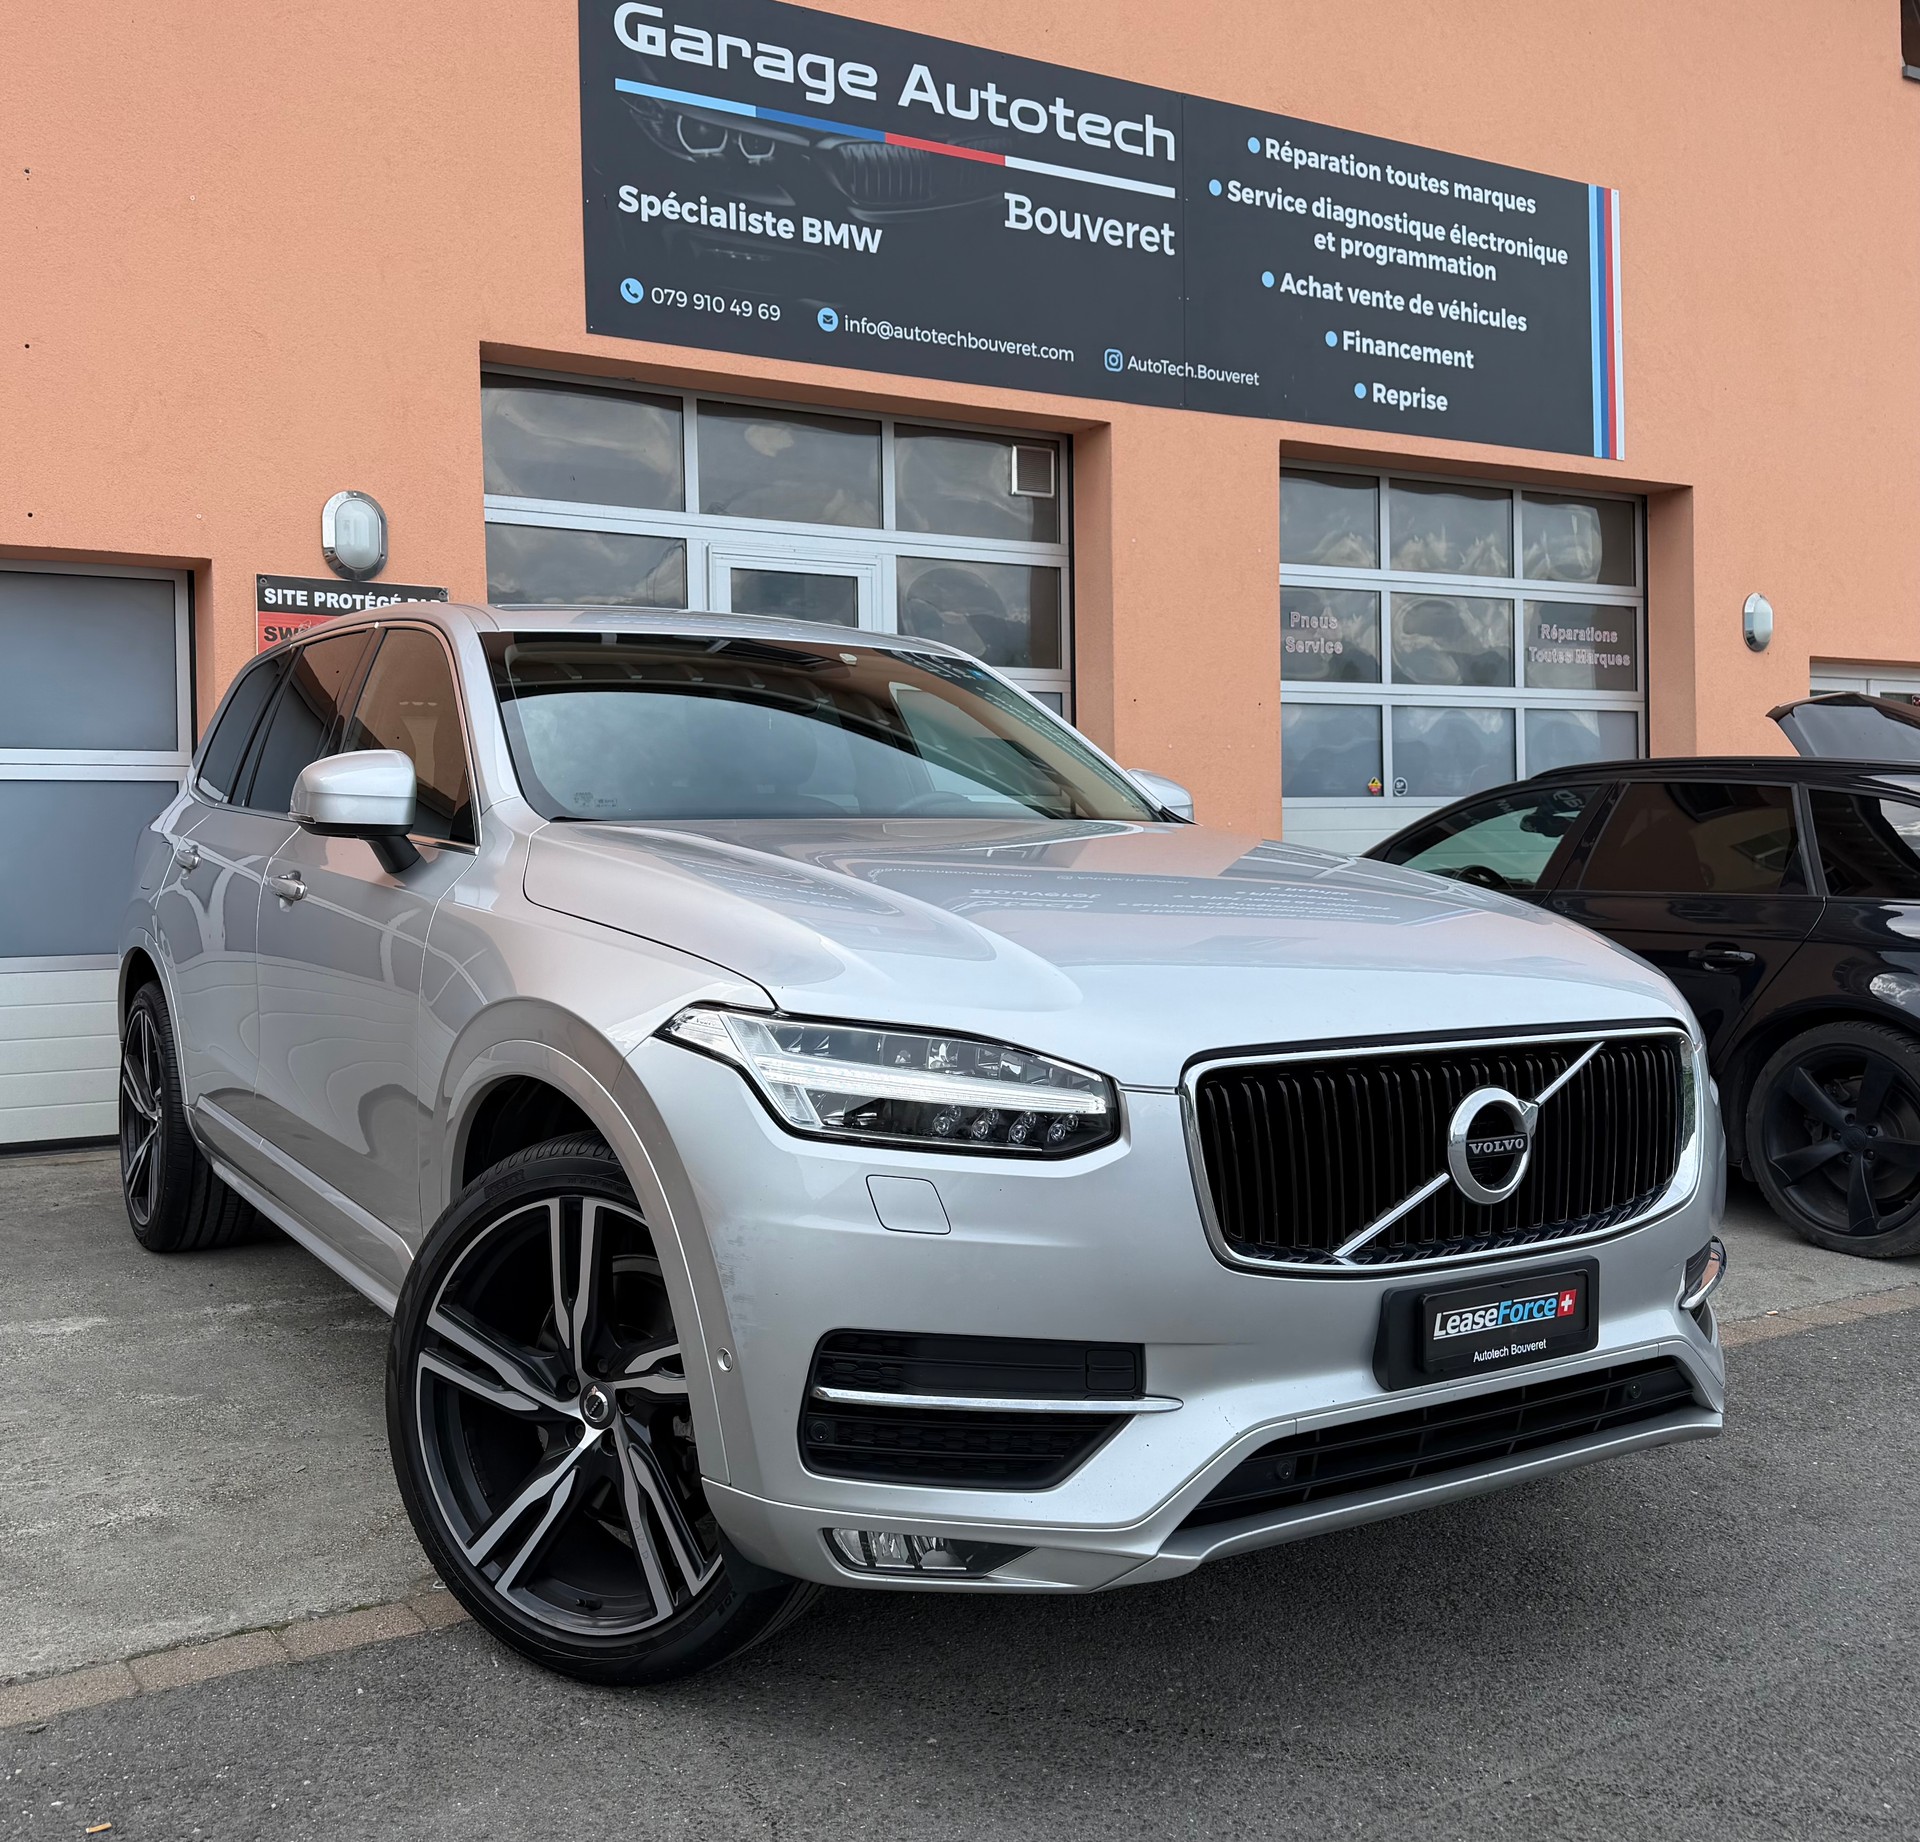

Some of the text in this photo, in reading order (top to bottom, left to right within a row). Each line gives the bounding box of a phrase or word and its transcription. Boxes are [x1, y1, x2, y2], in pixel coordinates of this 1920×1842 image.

[613, 1, 1175, 162] Garage Autotech
[1265, 137, 1537, 214] Réparation toutes marques
[618, 185, 883, 254] Spécialiste BMW
[1004, 192, 1175, 256] Bouveret
[1227, 180, 1569, 266] Service diagnostique électronique
[1314, 231, 1497, 281] et programmation
[651, 287, 781, 321] 079 910 49 69
[1280, 272, 1528, 332] Achat vente de véhicules
[844, 315, 1075, 363] info@autotechbouveret.com
[1343, 330, 1475, 369] Financement
[1127, 355, 1260, 386] AutoTech.Bouveret
[1373, 382, 1448, 412] Reprise
[264, 588, 308, 607] SITE
[1290, 611, 1338, 629] Pneus
[1540, 623, 1618, 643] Réparations
[1285, 636, 1343, 654] Service
[1528, 646, 1631, 668] Toutes Marques
[1469, 1137, 1525, 1155] VOLVO
[1433, 1295, 1557, 1337] LeaseForce
[1473, 1338, 1547, 1363] Autotech Bouveret
